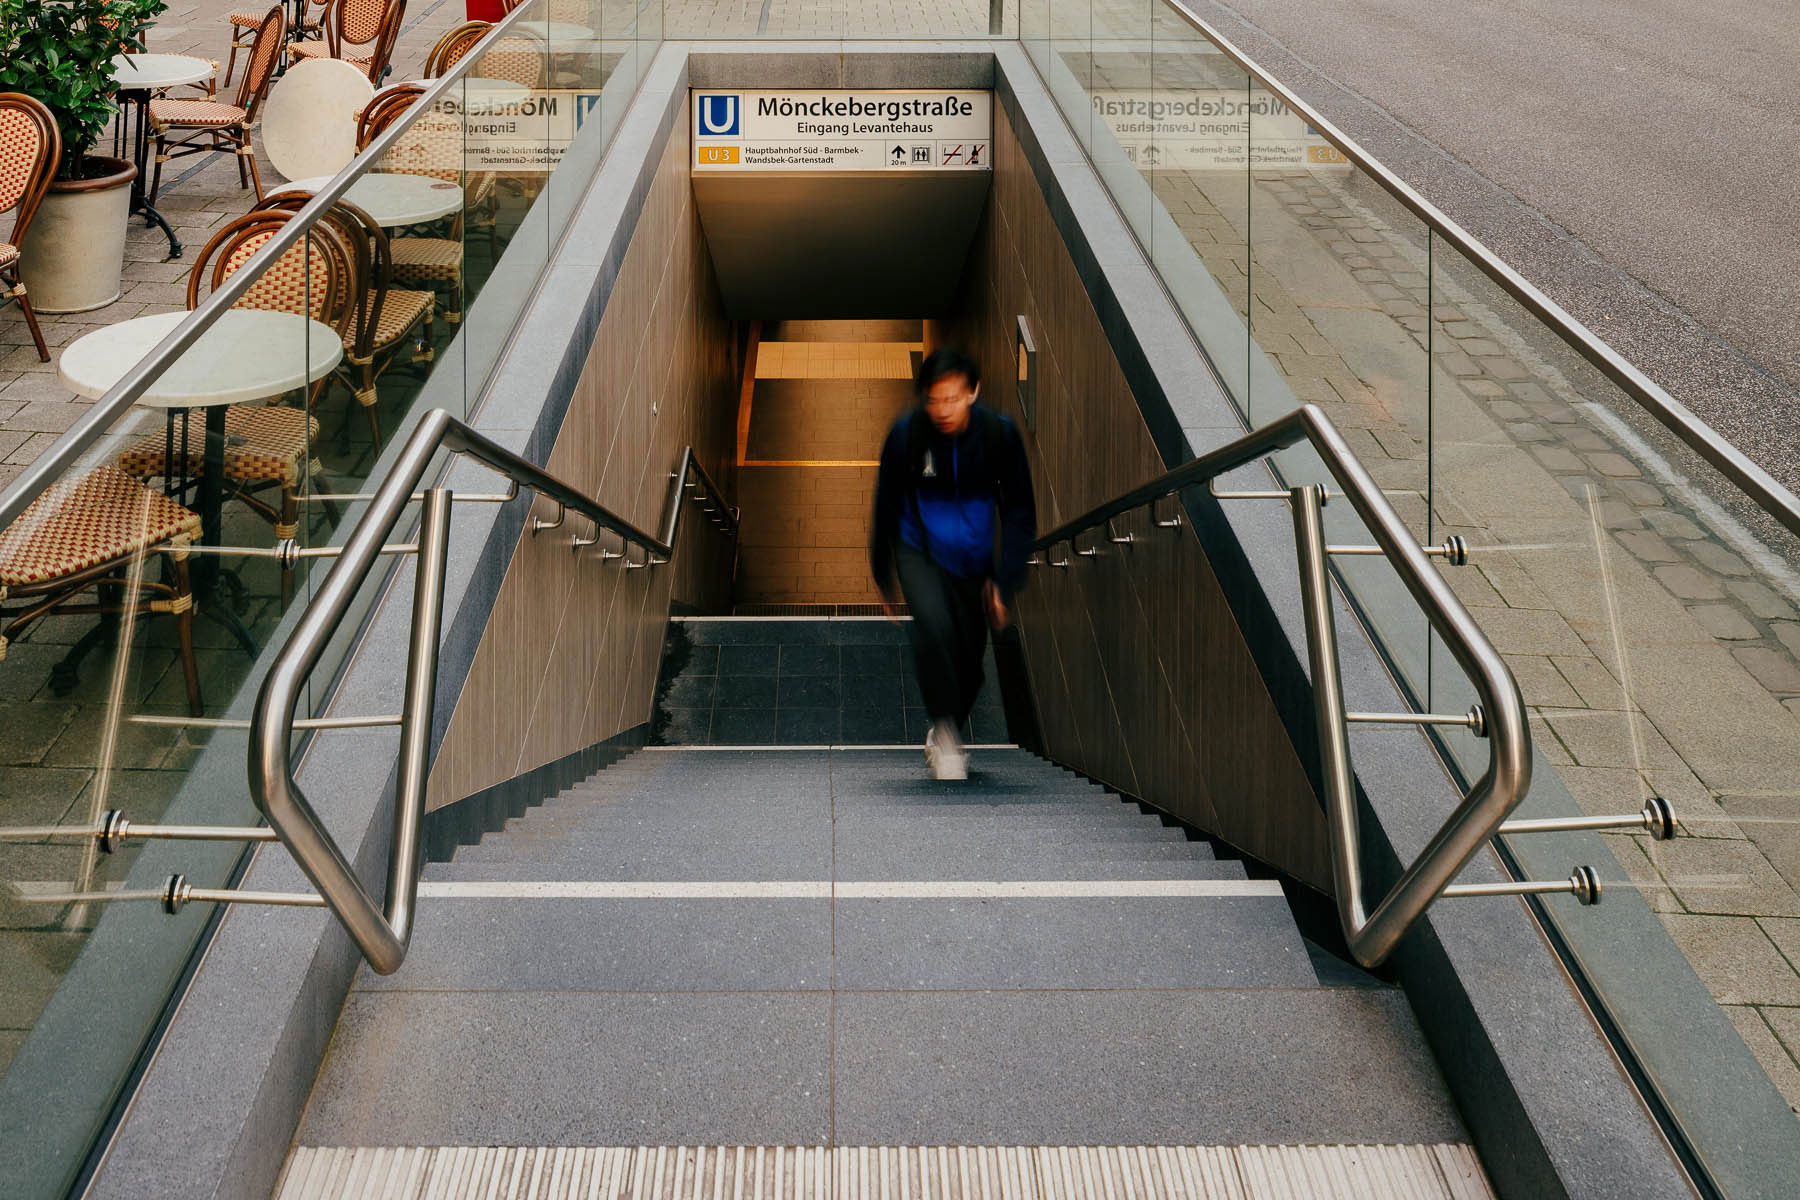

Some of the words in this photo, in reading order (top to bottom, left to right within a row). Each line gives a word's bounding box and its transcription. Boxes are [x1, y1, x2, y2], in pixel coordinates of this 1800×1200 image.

[757, 96, 973, 120] Mönckebergstraße
[703, 97, 735, 133] U
[797, 122, 849, 135] Eingang
[853, 122, 933, 134] Levantehaus
[745, 146, 802, 156] Hauptbahnhof
[804, 146, 818, 154] Süd
[824, 146, 859, 154] Barmbek
[745, 156, 834, 164] Wandsbek-Gartenstadt
